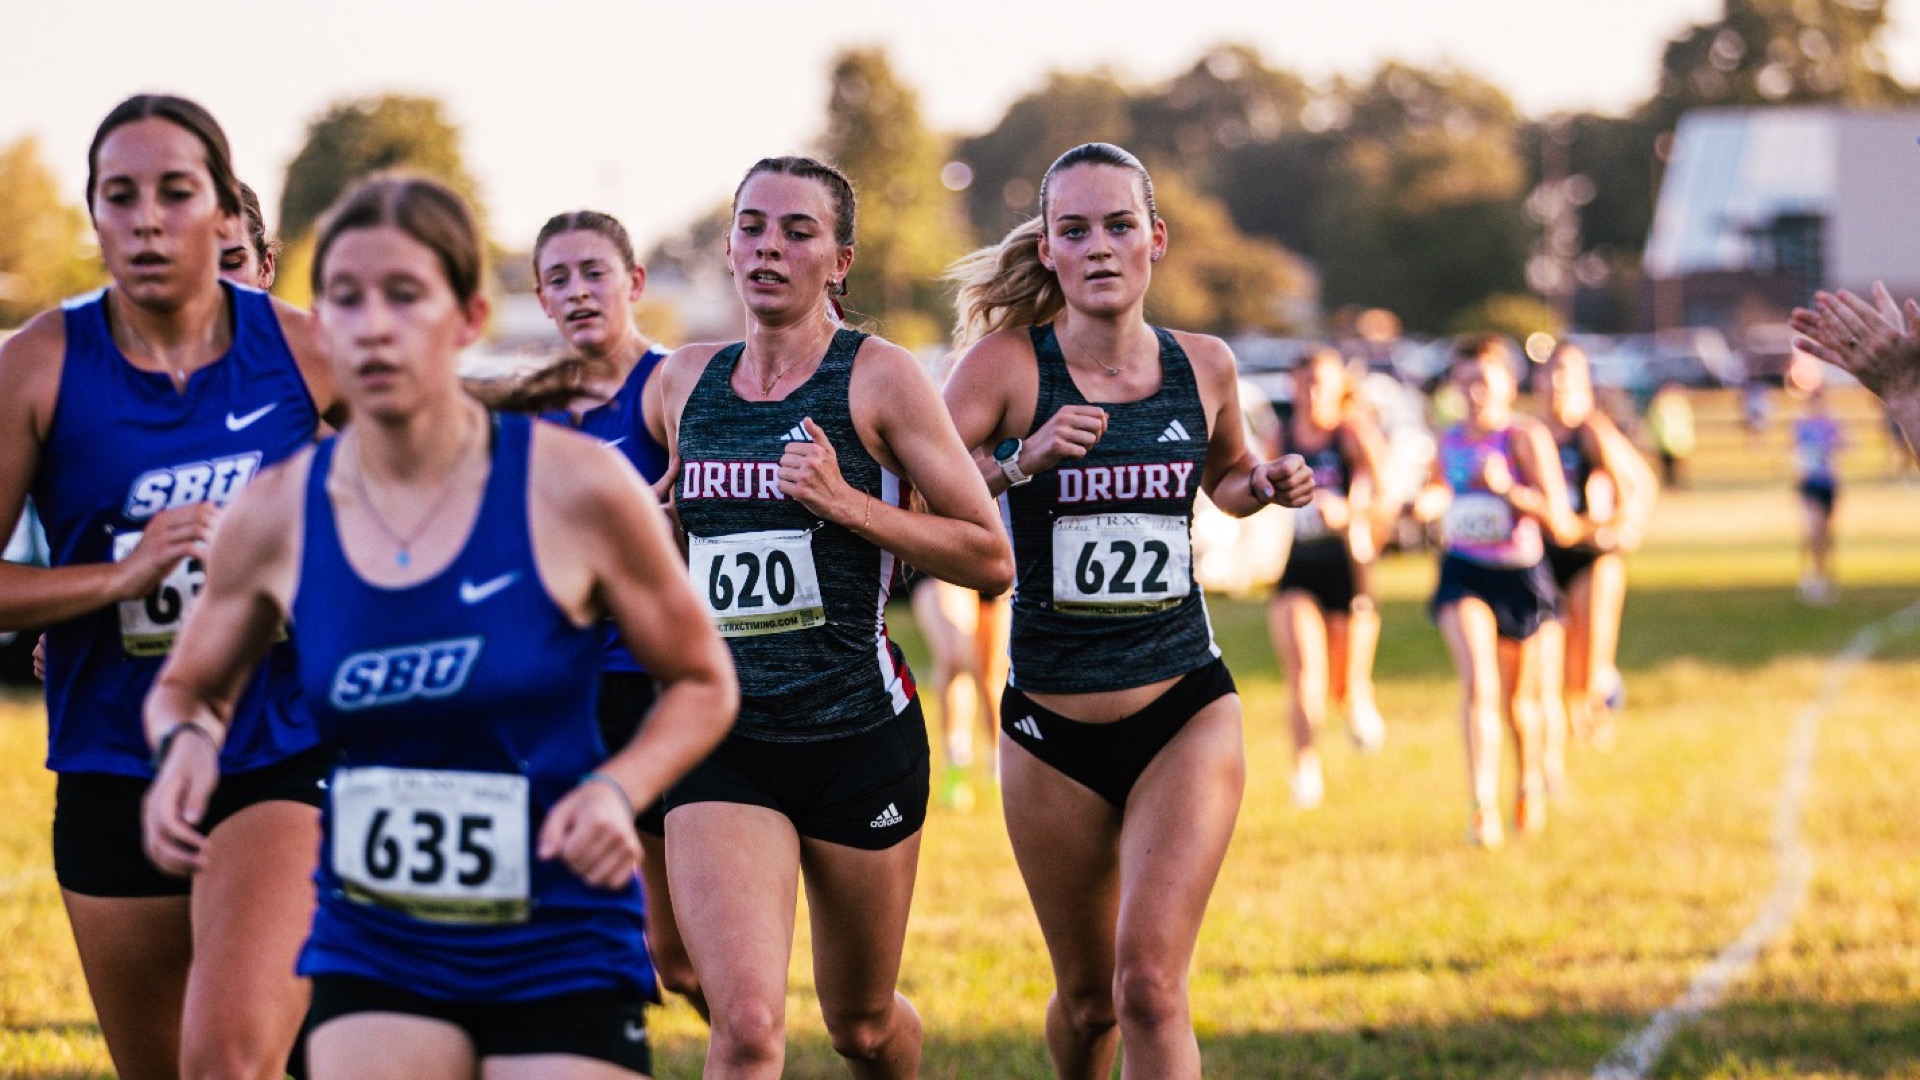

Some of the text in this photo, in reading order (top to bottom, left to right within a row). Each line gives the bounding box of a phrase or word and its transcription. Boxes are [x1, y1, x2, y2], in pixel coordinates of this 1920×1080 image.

[124, 450, 263, 520] SBU
[682, 460, 786, 500] DRUR
[1057, 461, 1194, 503] DRURY
[708, 549, 795, 611] 620
[1075, 539, 1170, 595] 622
[330, 636, 483, 710] SBU
[364, 807, 494, 888] 635
[870, 814, 903, 828] adidas
